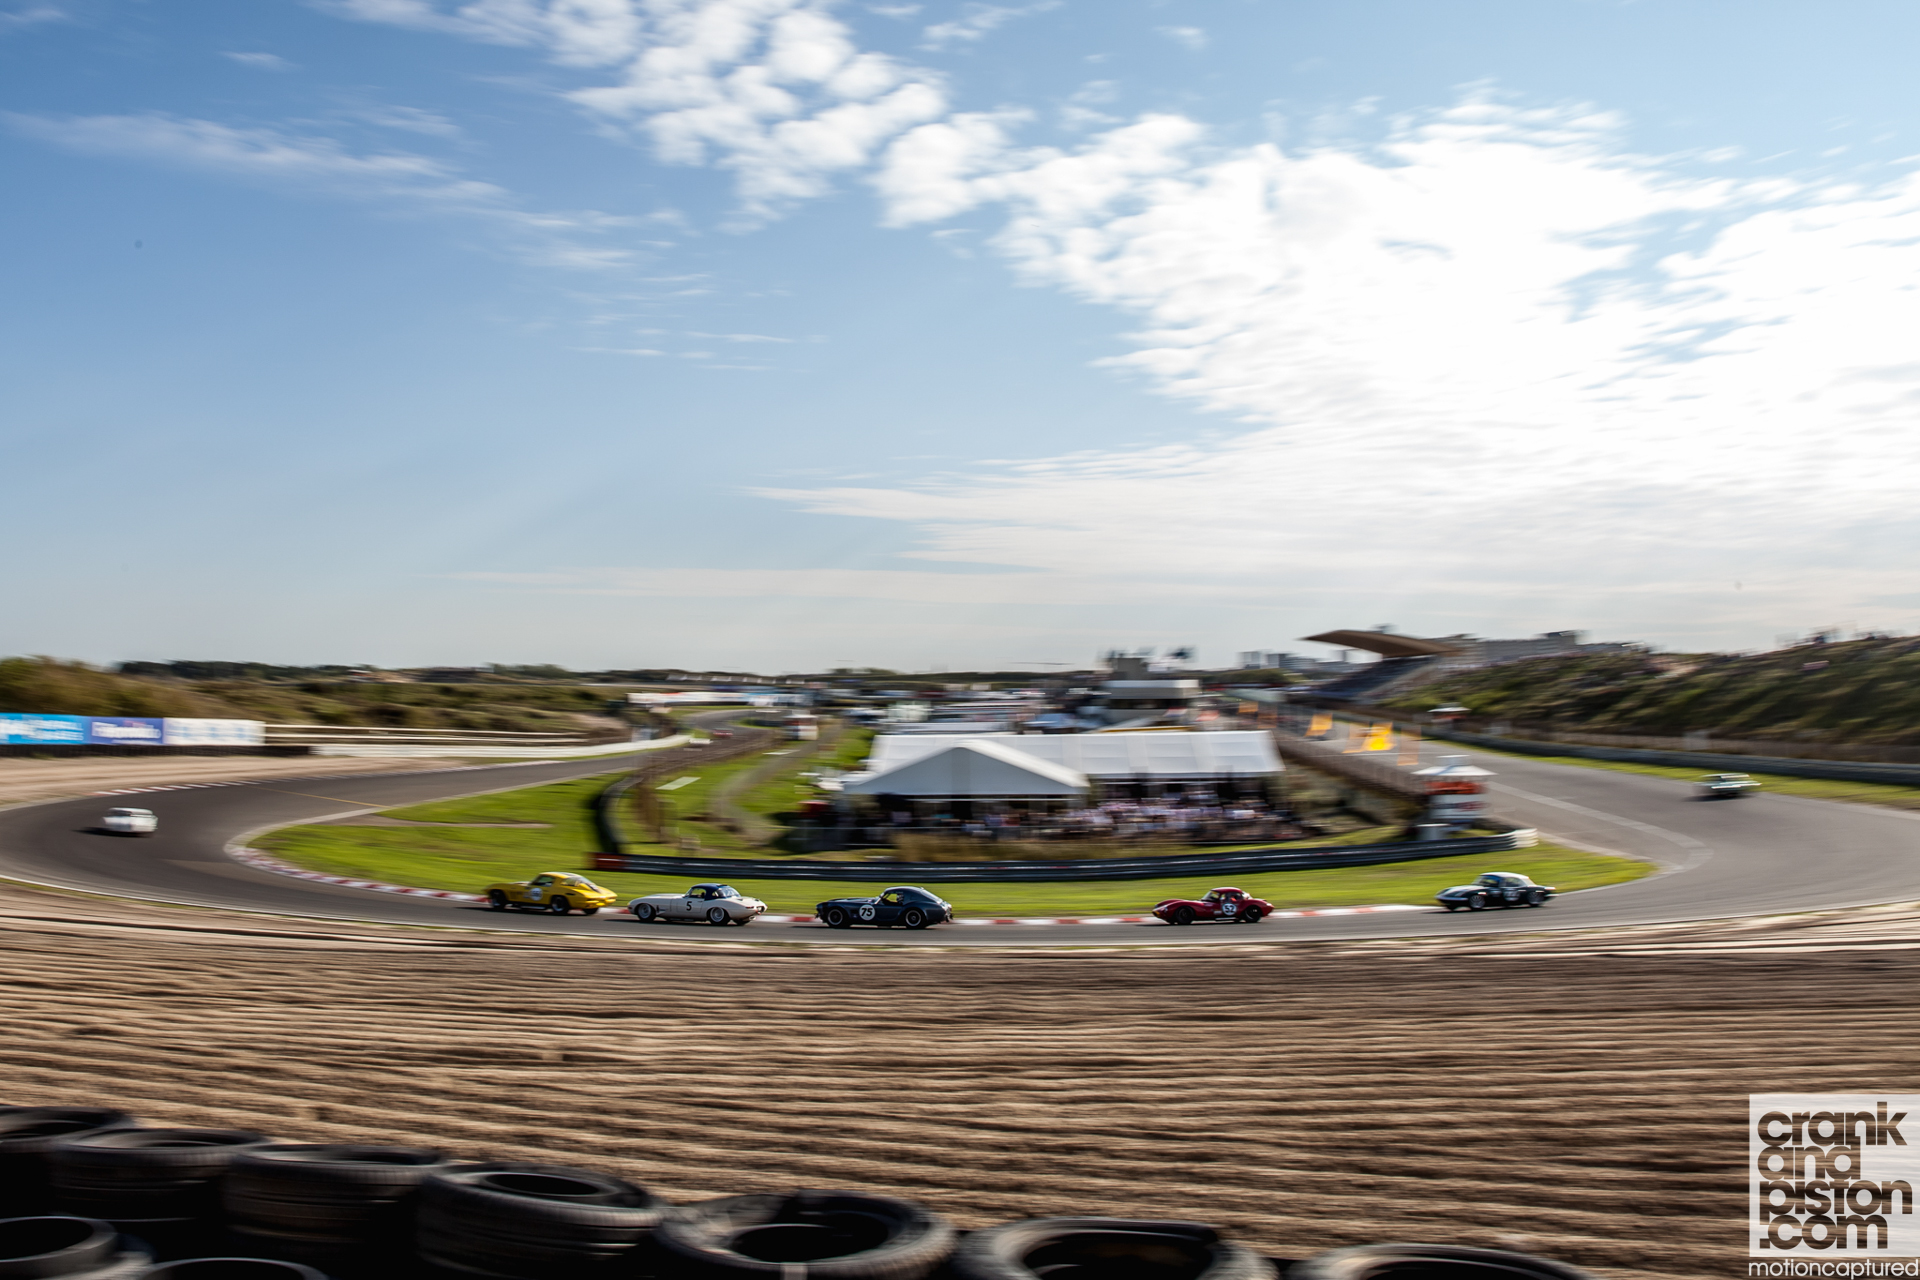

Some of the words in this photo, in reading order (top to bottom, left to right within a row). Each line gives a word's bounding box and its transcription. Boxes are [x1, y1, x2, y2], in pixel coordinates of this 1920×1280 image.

[686, 901, 693, 911] 5
[1225, 905, 1235, 913] 52
[861, 908, 873, 917] 75
